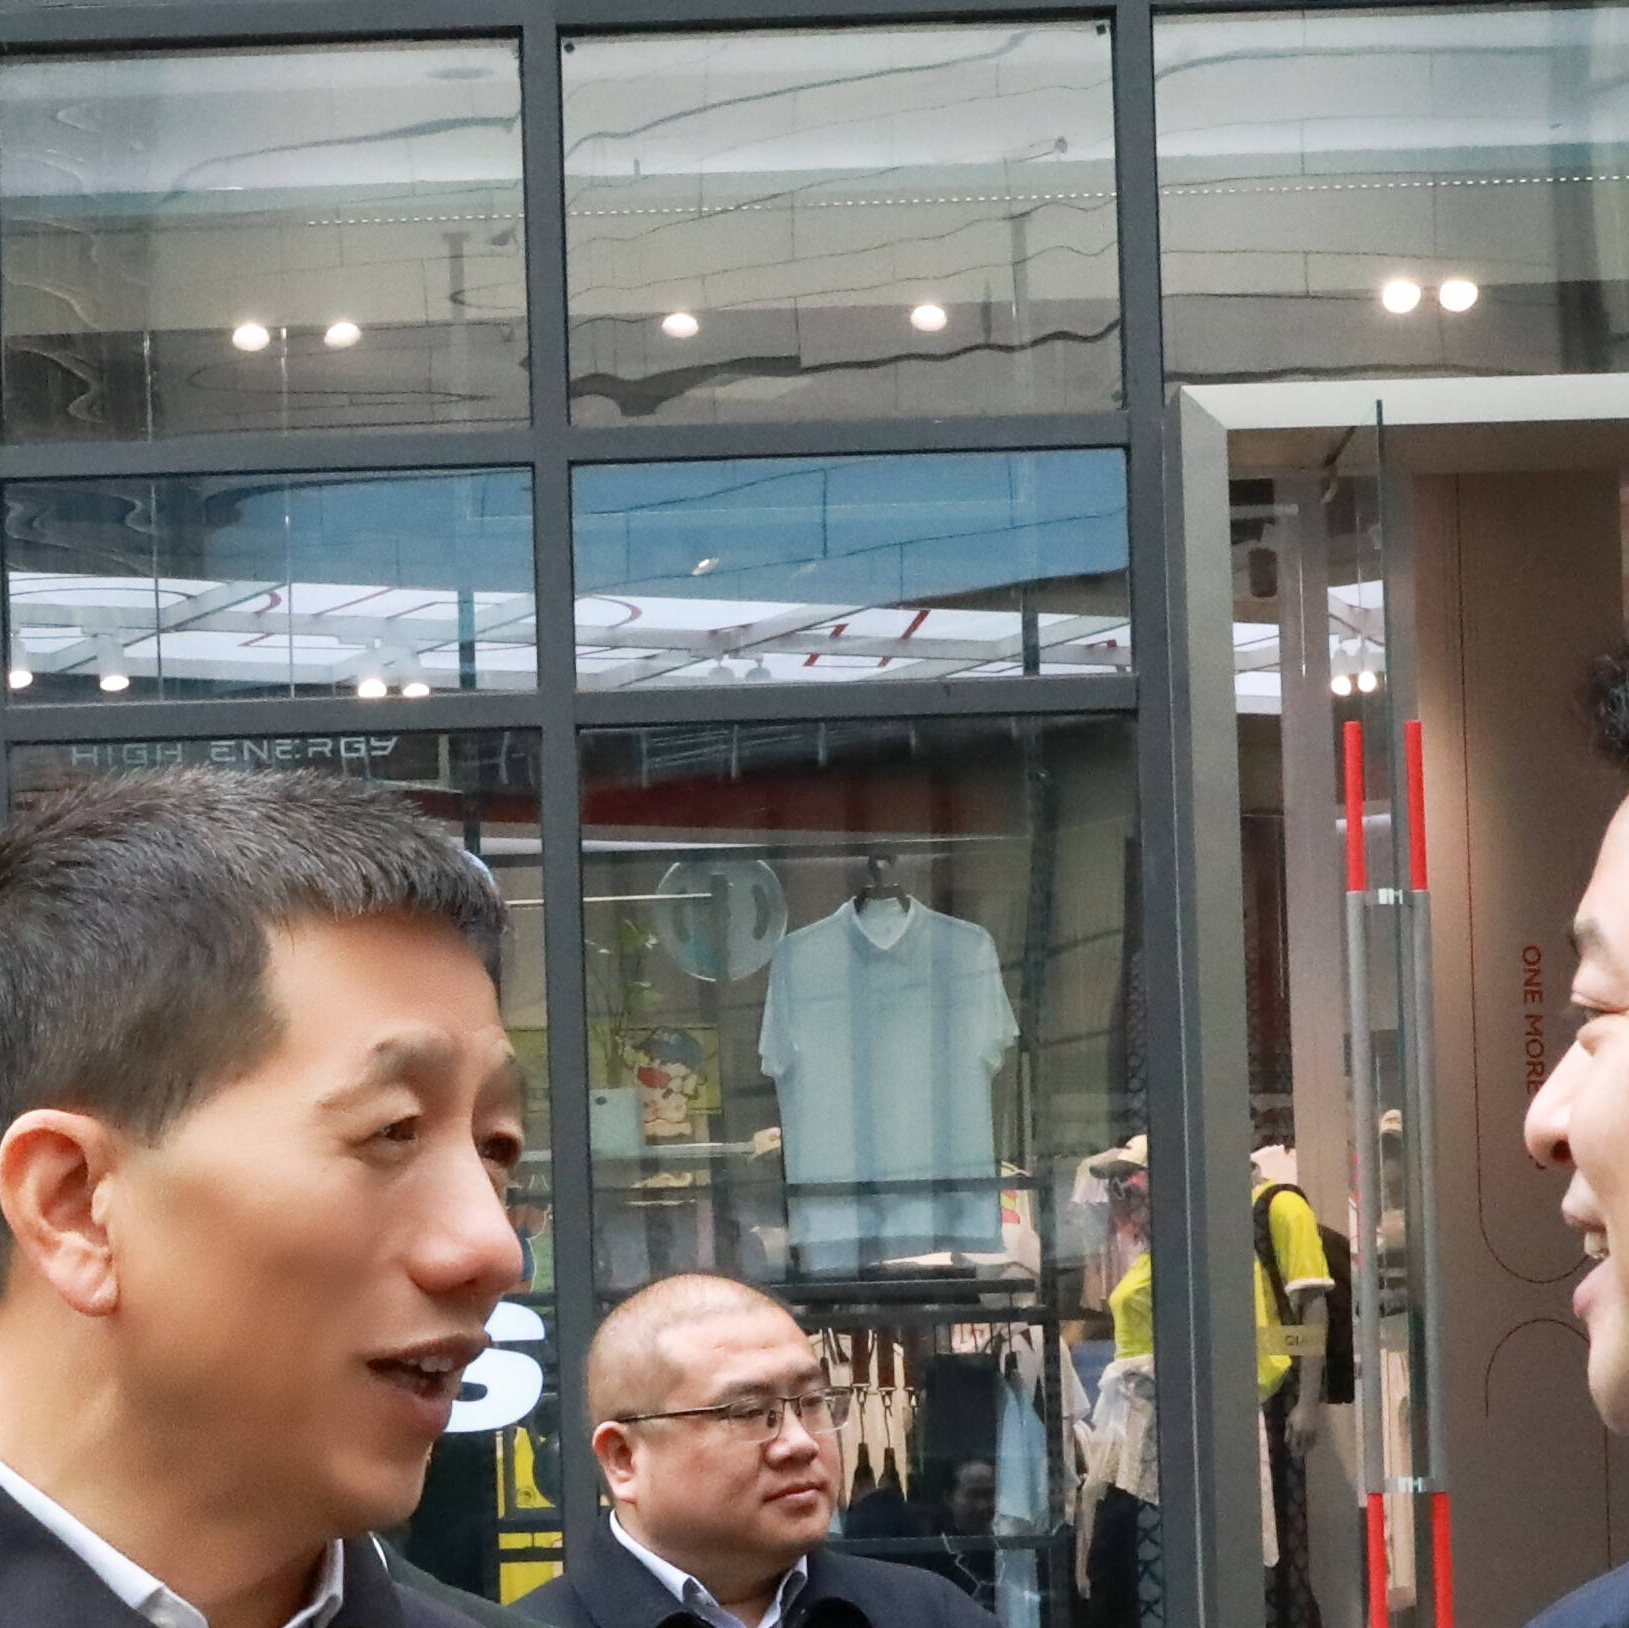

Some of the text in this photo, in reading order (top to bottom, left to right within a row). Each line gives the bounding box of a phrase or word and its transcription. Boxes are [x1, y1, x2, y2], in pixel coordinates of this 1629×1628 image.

[72, 736, 398, 767] HIGH ENERGY
[1523, 945, 1543, 1004] ONE
